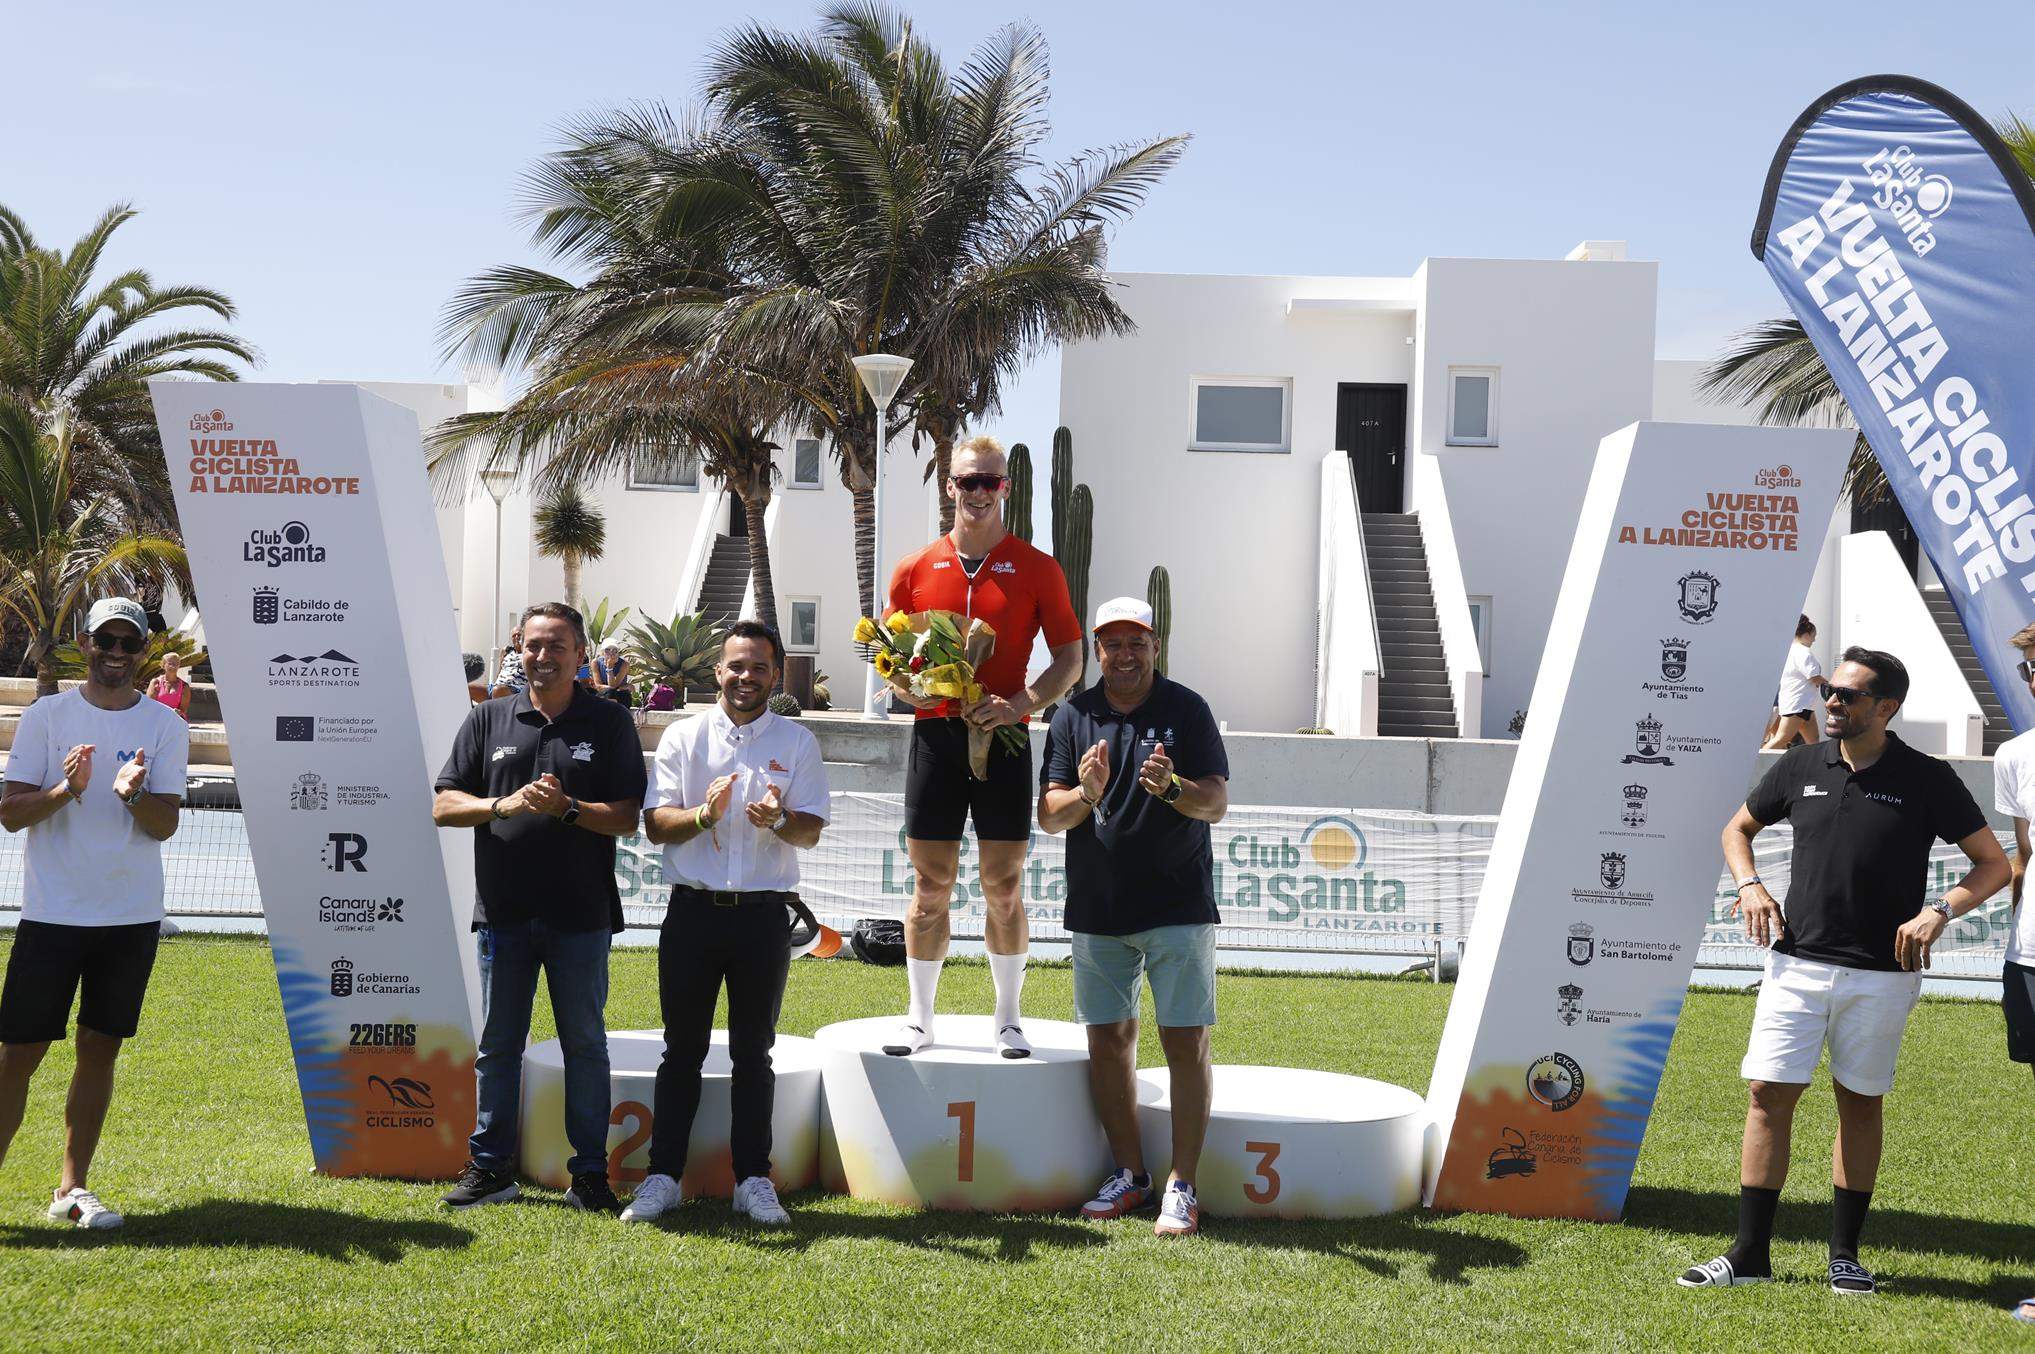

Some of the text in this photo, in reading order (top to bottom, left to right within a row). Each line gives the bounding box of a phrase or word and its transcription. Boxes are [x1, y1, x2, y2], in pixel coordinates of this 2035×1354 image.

[1891, 145, 1923, 187] Club
[1819, 178, 2035, 606] VUELTA CICLIS
[1777, 215, 2008, 595] A LANZAROTE
[193, 413, 210, 422] Club
[190, 439, 279, 457] VUELTA
[189, 457, 300, 476] CICLISTA
[1759, 468, 1777, 478] Club
[190, 476, 360, 495] A LANZAROTE
[1706, 492, 1800, 513] VUELTA
[1681, 510, 1798, 533] CICLISTA
[250, 529, 282, 545] Club
[1618, 526, 1798, 551] A LANZAROTE
[283, 599, 350, 610] Cabildo de
[283, 611, 345, 622] Lanzarote
[268, 667, 360, 677] LANZAROTE
[268, 679, 301, 687] SPORTS
[1642, 682, 1704, 693] Ayuntamiento
[1657, 691, 1668, 699] de
[319, 716, 375, 726] Financiado por
[349, 726, 378, 735] Europea
[1666, 734, 1722, 745] Ayuntamiento
[1665, 744, 1702, 753] de YAIZA
[1228, 834, 1301, 869] Club
[319, 896, 376, 912] Canary
[319, 910, 375, 922] Islands
[1303, 918, 1444, 934] LANZAROTE
[1601, 938, 1681, 951] Ayuntamiento de
[1600, 949, 1673, 961] San Bartolomé
[357, 973, 409, 983] Gobierno
[356, 984, 420, 994] de Canarias
[1586, 1008, 1632, 1017] Ayuntamiento
[350, 1023, 416, 1046] 226ERS
[1536, 1055, 1553, 1065] UCI
[1556, 1055, 1582, 1085] CYCLING
[366, 1117, 434, 1128] CICLISMO
[608, 1101, 654, 1183] 2
[947, 1101, 976, 1182] 1
[1242, 1141, 1282, 1204] 3
